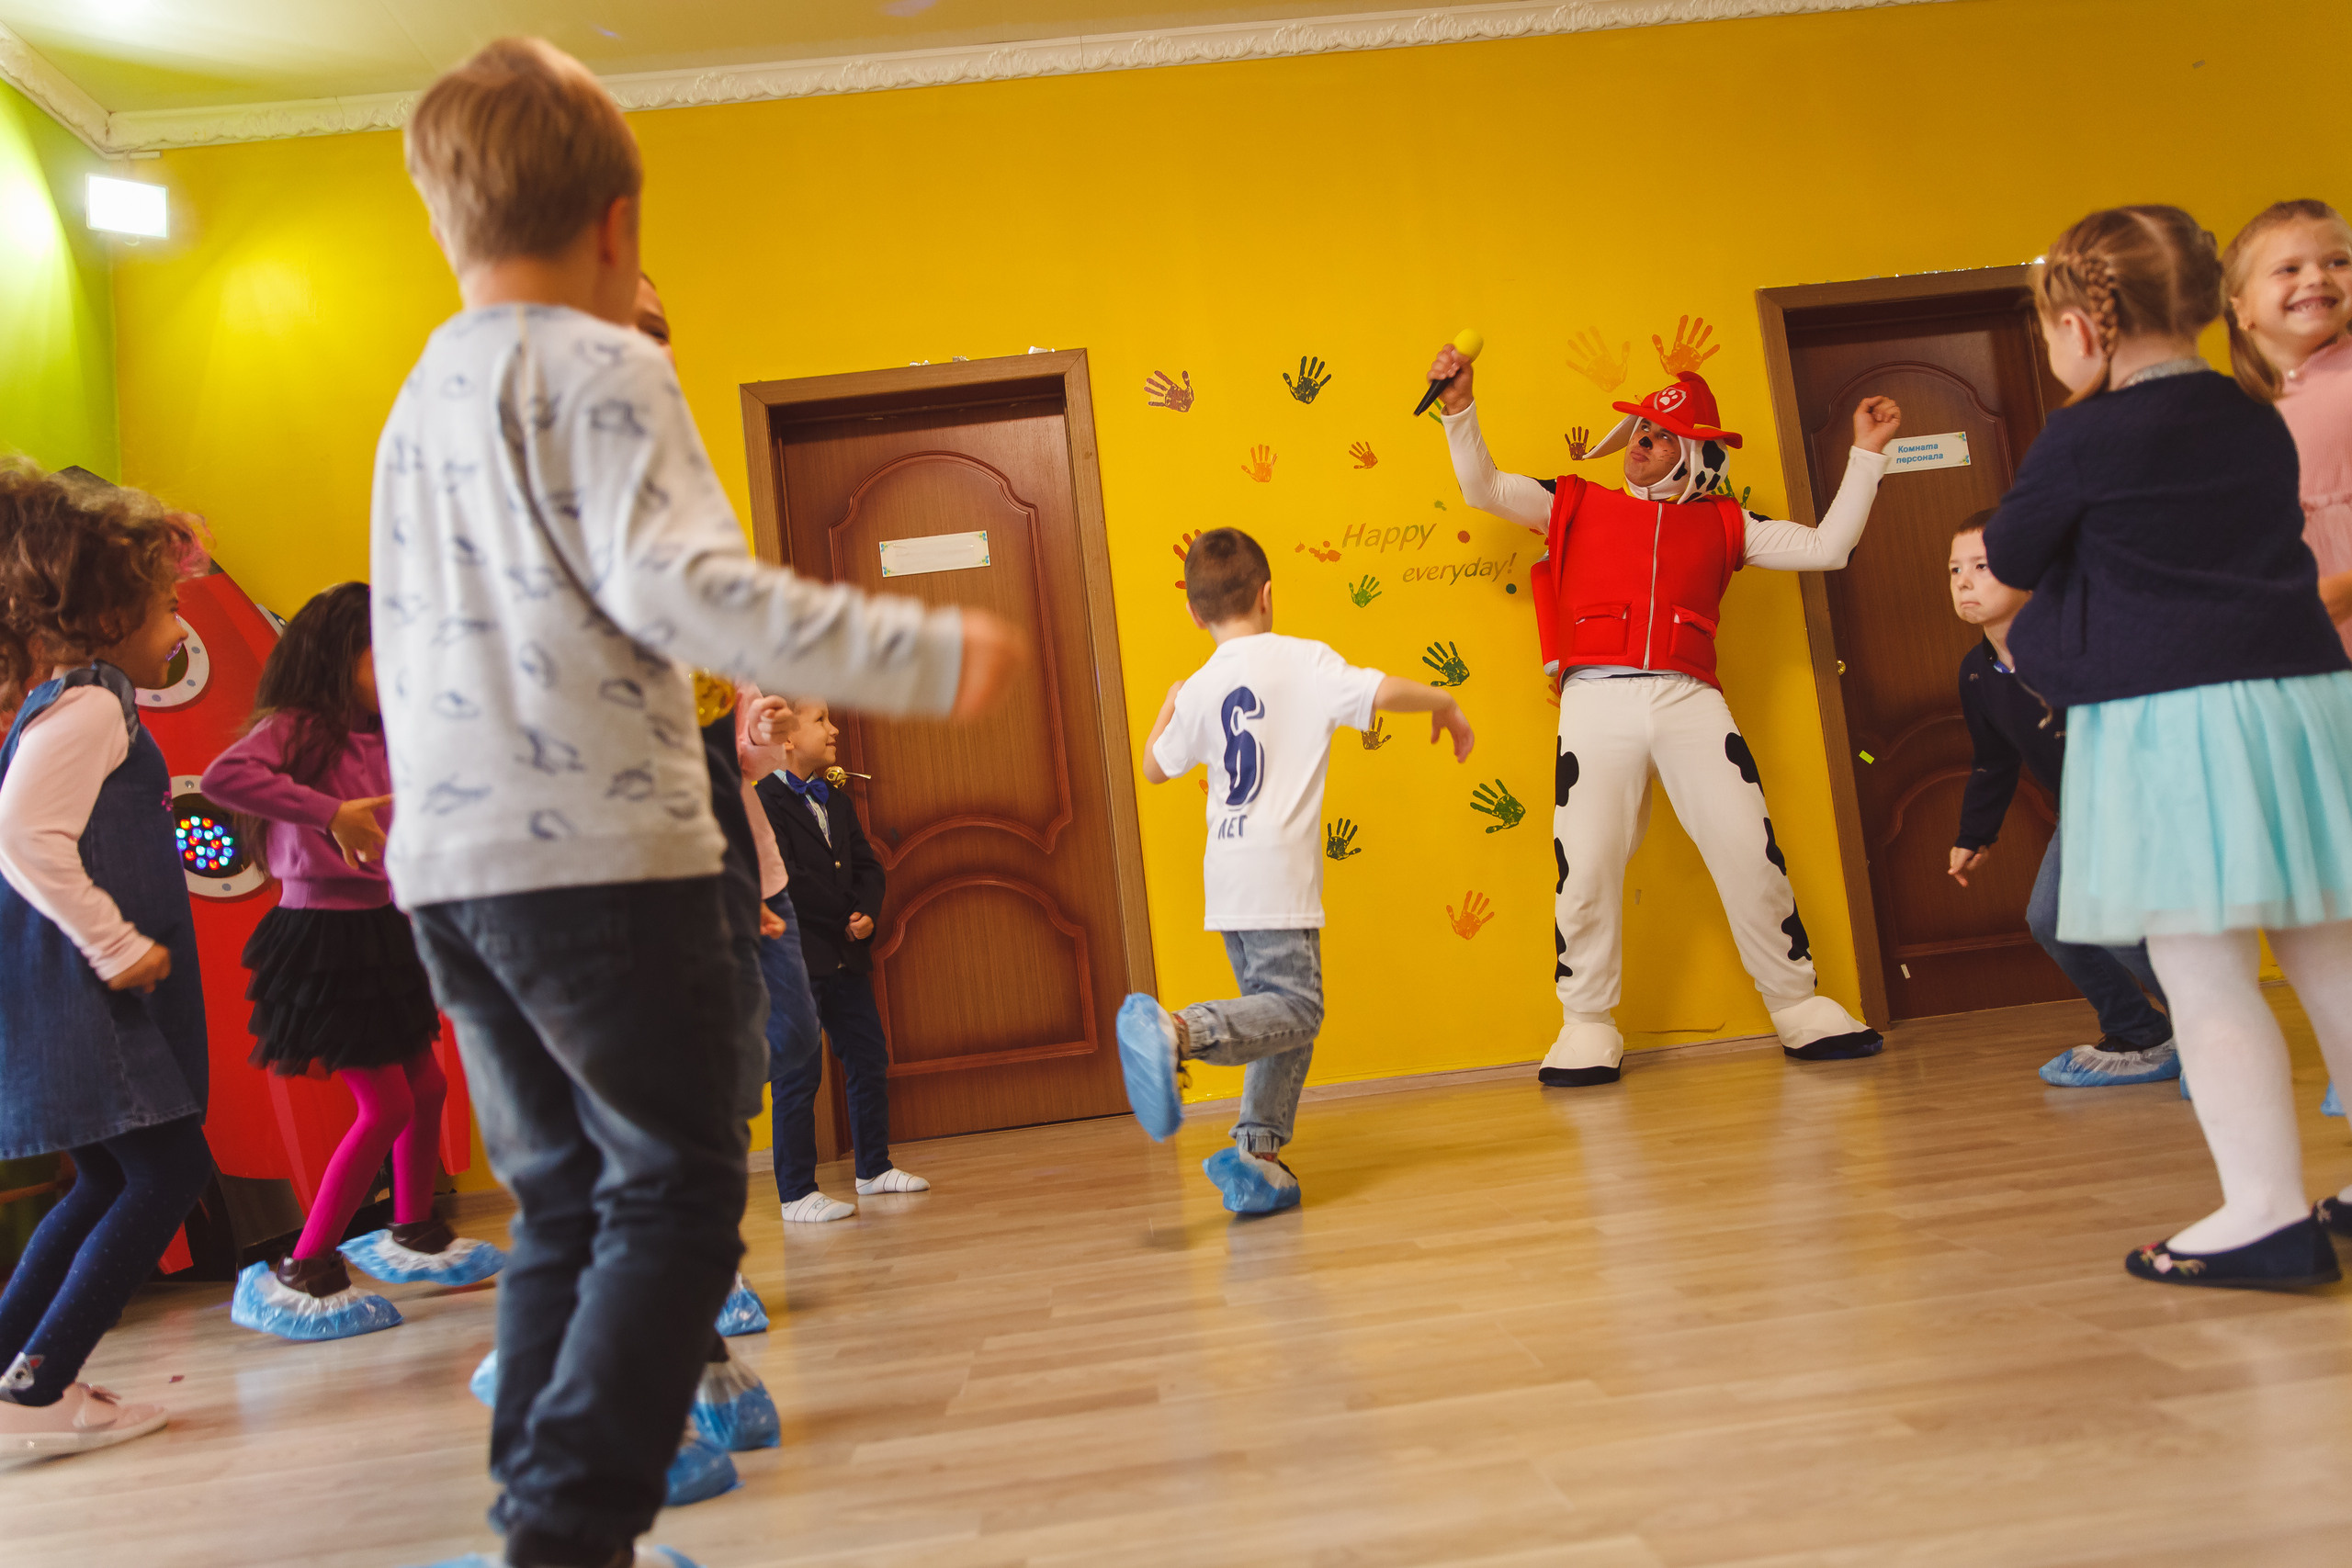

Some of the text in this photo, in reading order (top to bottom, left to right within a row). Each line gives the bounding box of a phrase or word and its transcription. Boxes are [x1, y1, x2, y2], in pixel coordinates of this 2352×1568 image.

[1896, 453, 1943, 464] персонала
[1897, 444, 1938, 453] Комната
[1342, 523, 1436, 553] Happy
[1402, 552, 1517, 585] everyday!
[1221, 685, 1265, 812] 6
